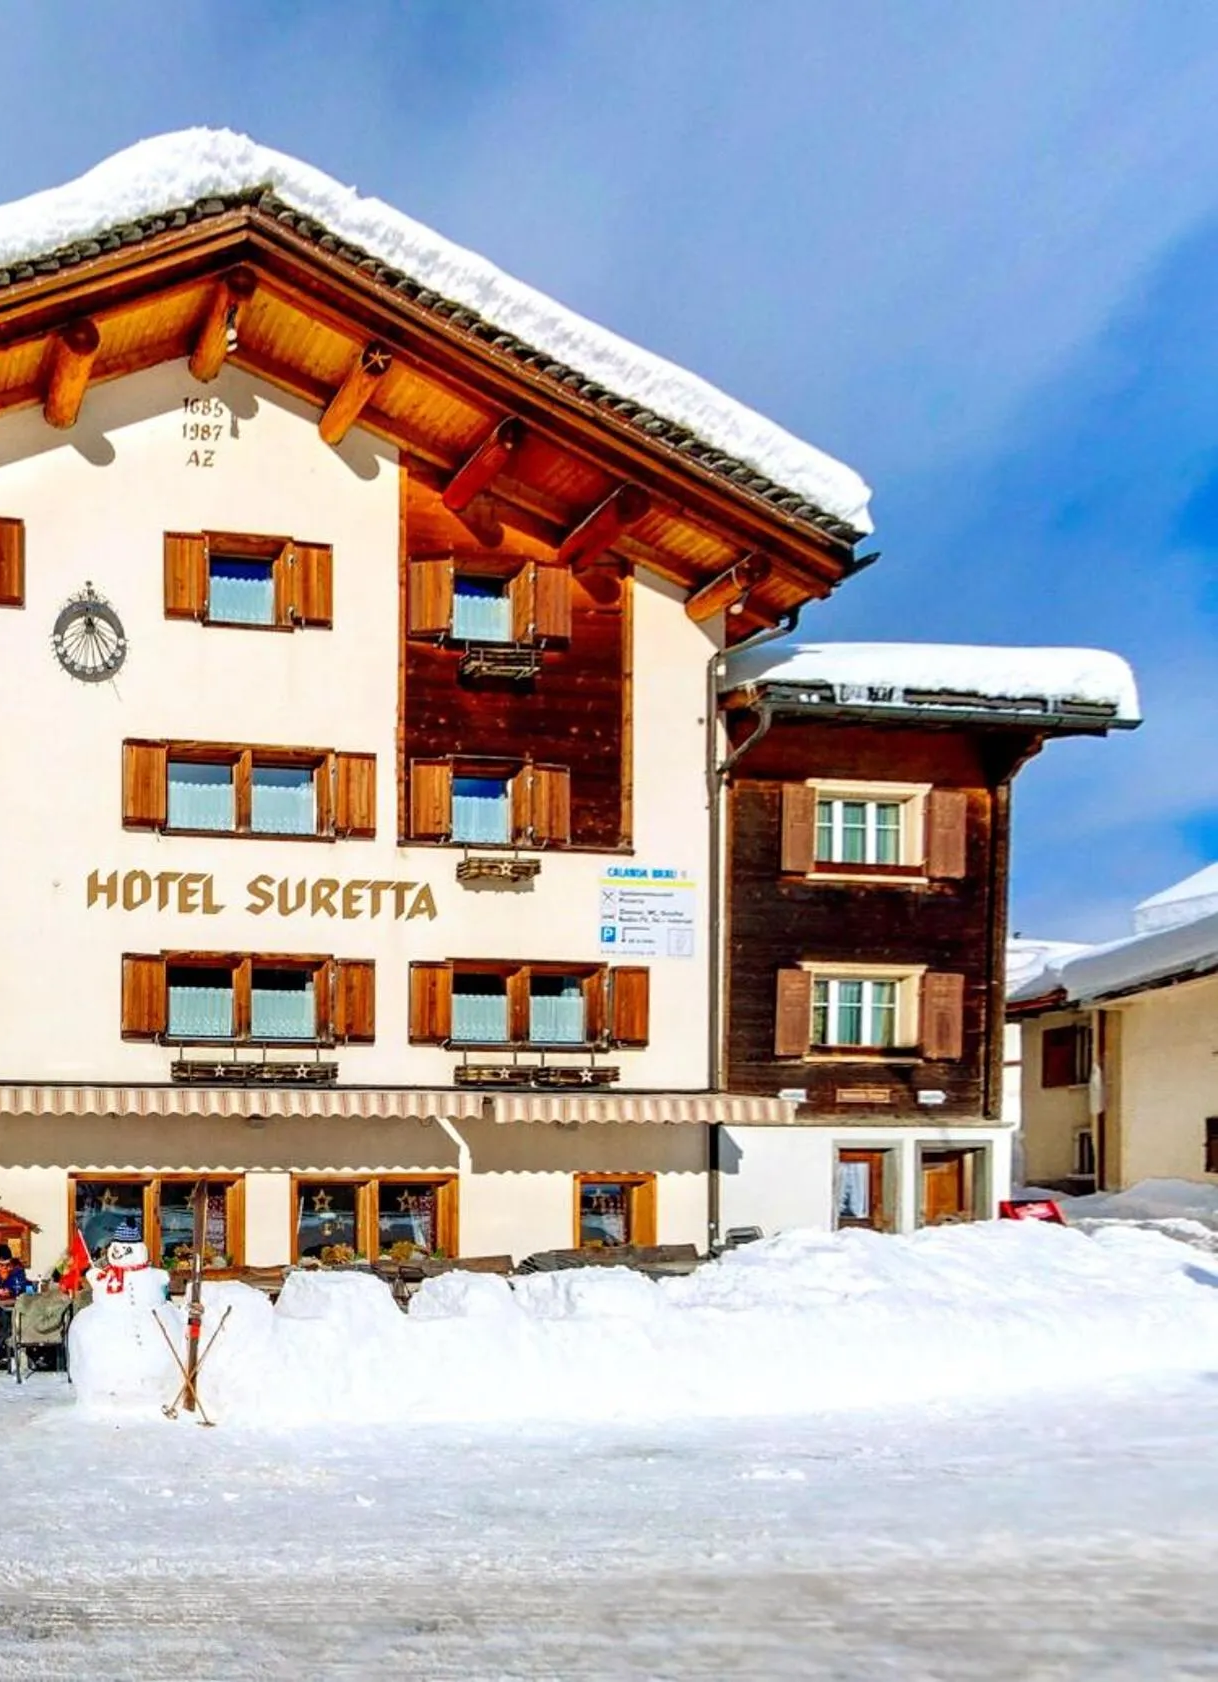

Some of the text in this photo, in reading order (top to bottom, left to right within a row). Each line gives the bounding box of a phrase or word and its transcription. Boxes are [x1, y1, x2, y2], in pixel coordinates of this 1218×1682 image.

[183, 397, 223, 418] 1685
[182, 422, 223, 441] 1987
[185, 449, 216, 467] AZ
[86, 868, 438, 922] HOTEL SURETTA
